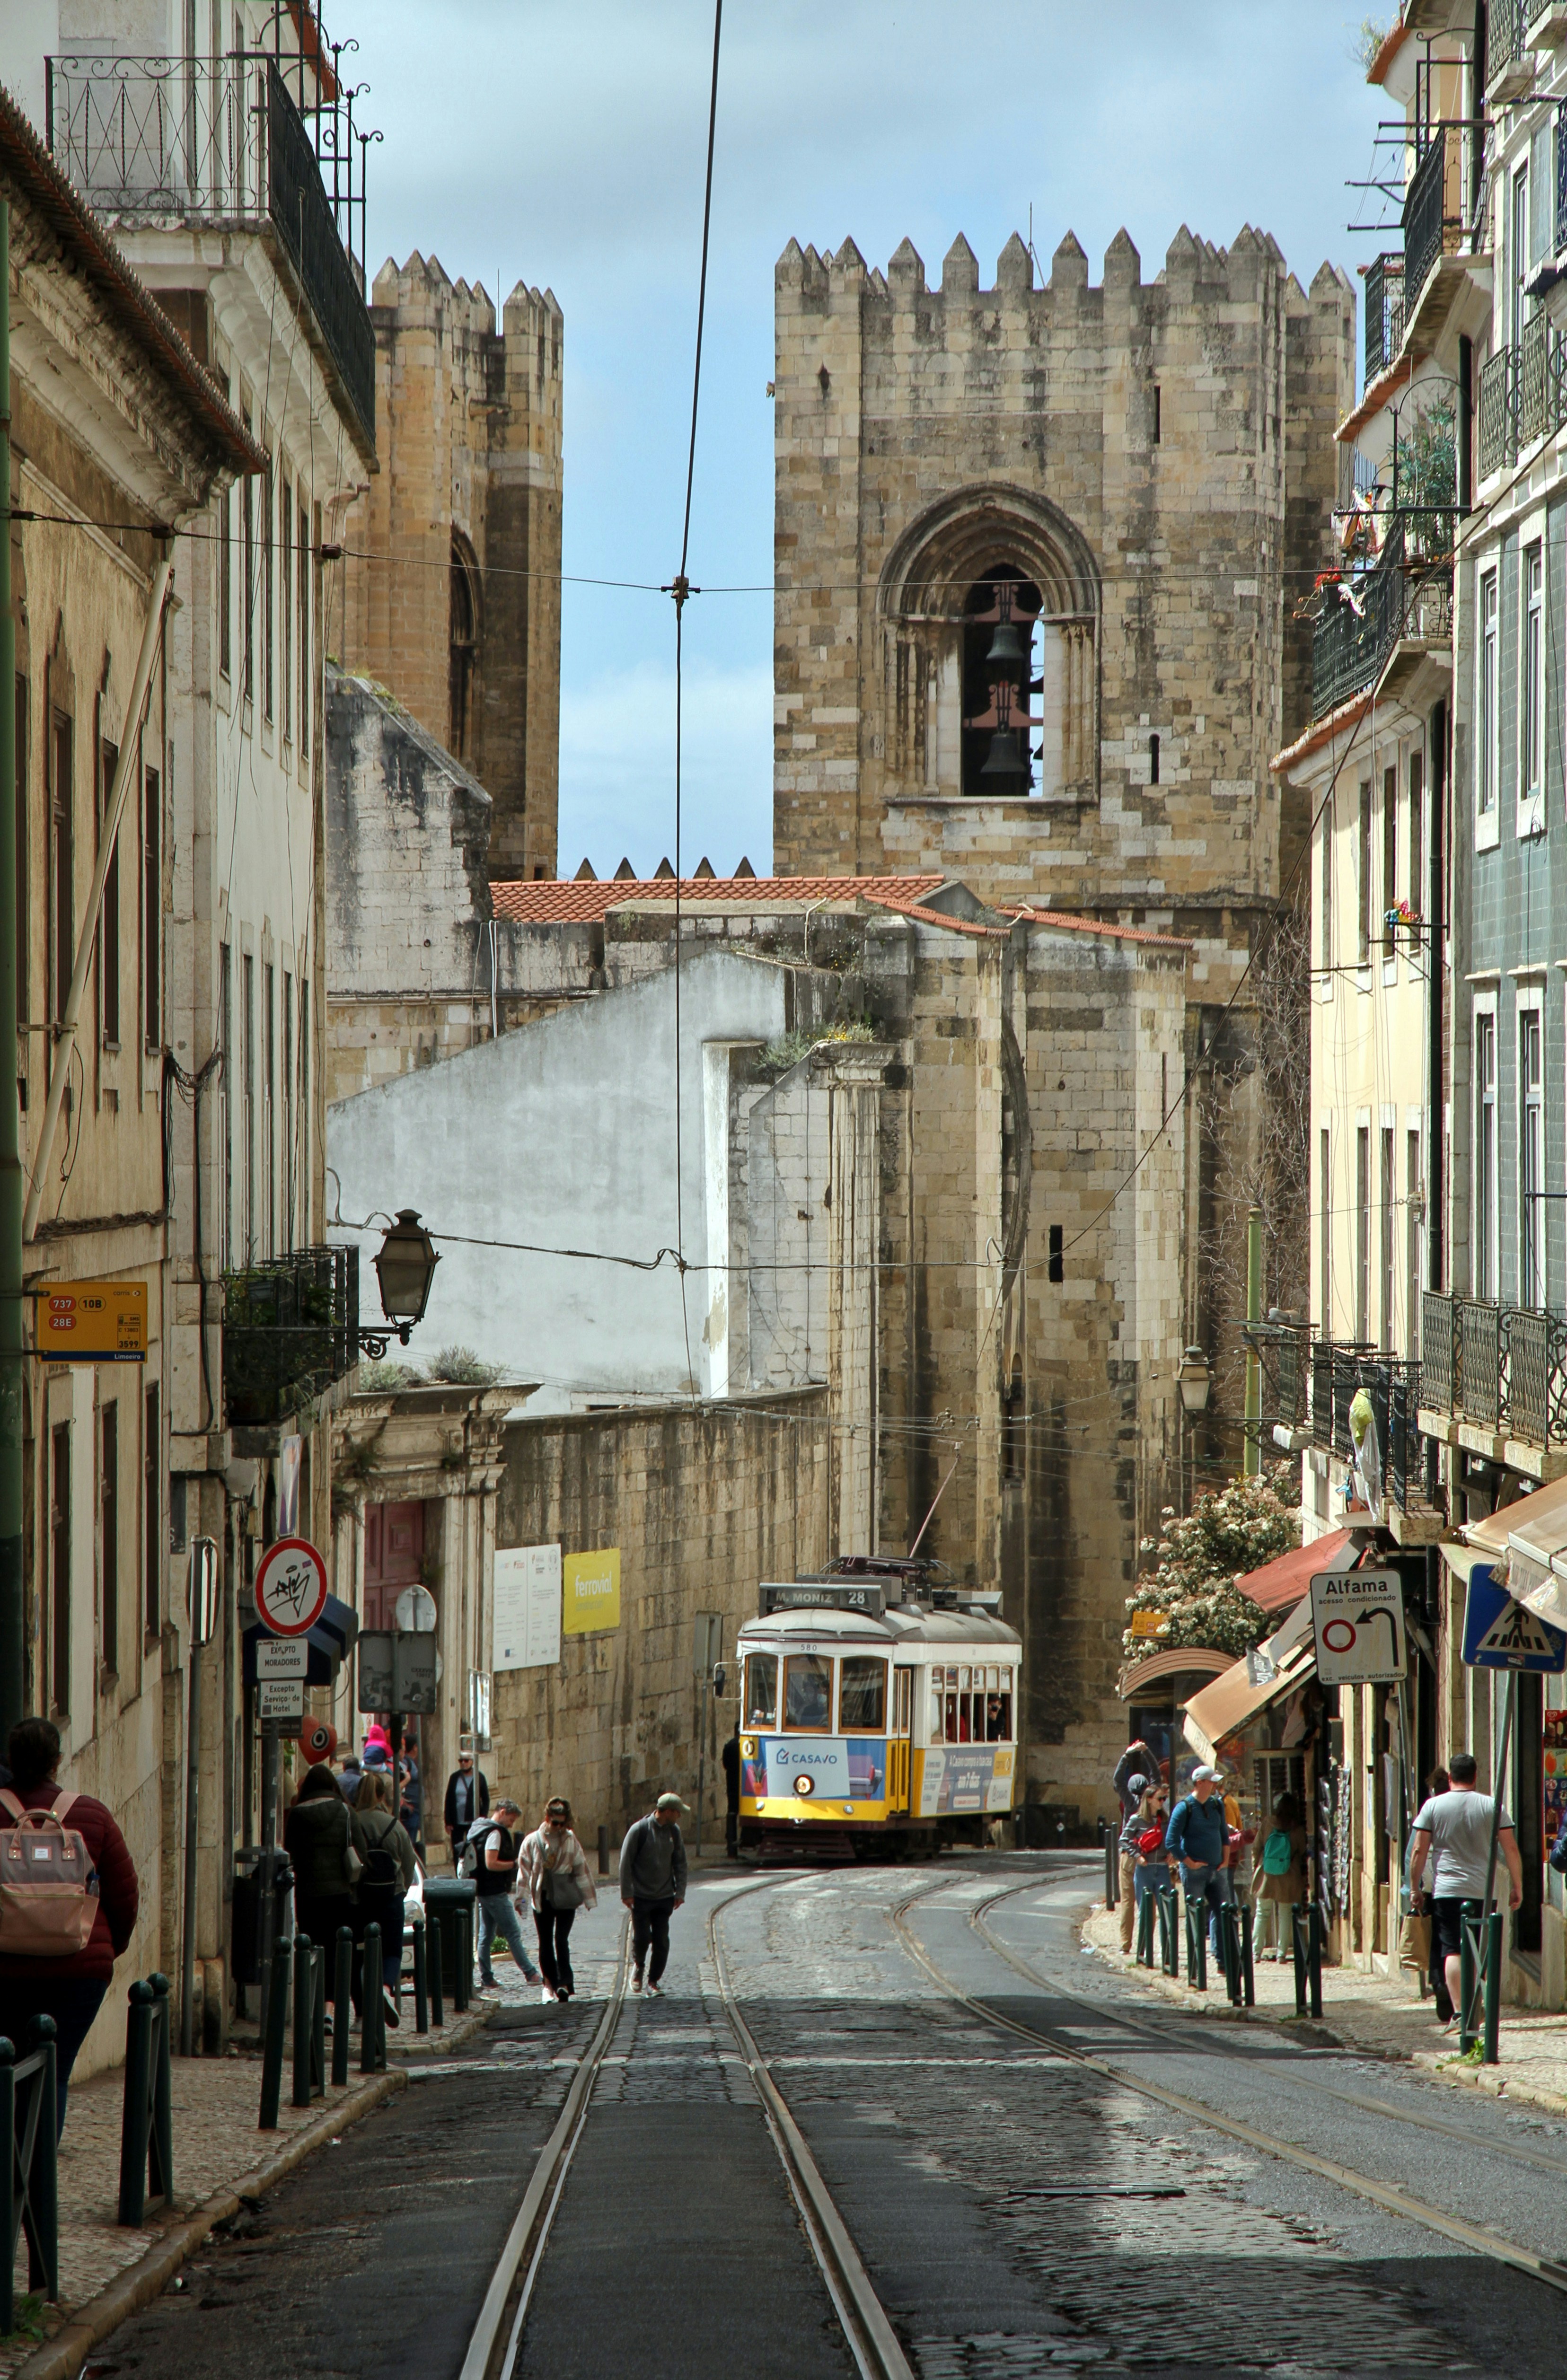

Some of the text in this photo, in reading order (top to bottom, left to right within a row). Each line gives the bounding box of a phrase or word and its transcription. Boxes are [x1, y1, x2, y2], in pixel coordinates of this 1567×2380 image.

[53, 1300, 102, 1309] 737 10B
[53, 1318, 72, 1327] 28E
[575, 1570, 613, 1598] ferrovial
[1325, 1579, 1388, 1595] Alfama
[776, 1592, 833, 1603] M. MONIZ
[848, 1591, 865, 1605] 28
[1347, 1595, 1396, 1603] condicionado
[264, 1658, 301, 1667] MORADORES
[264, 1695, 288, 1703] Serviço
[792, 1754, 838, 1765] CASAVO
